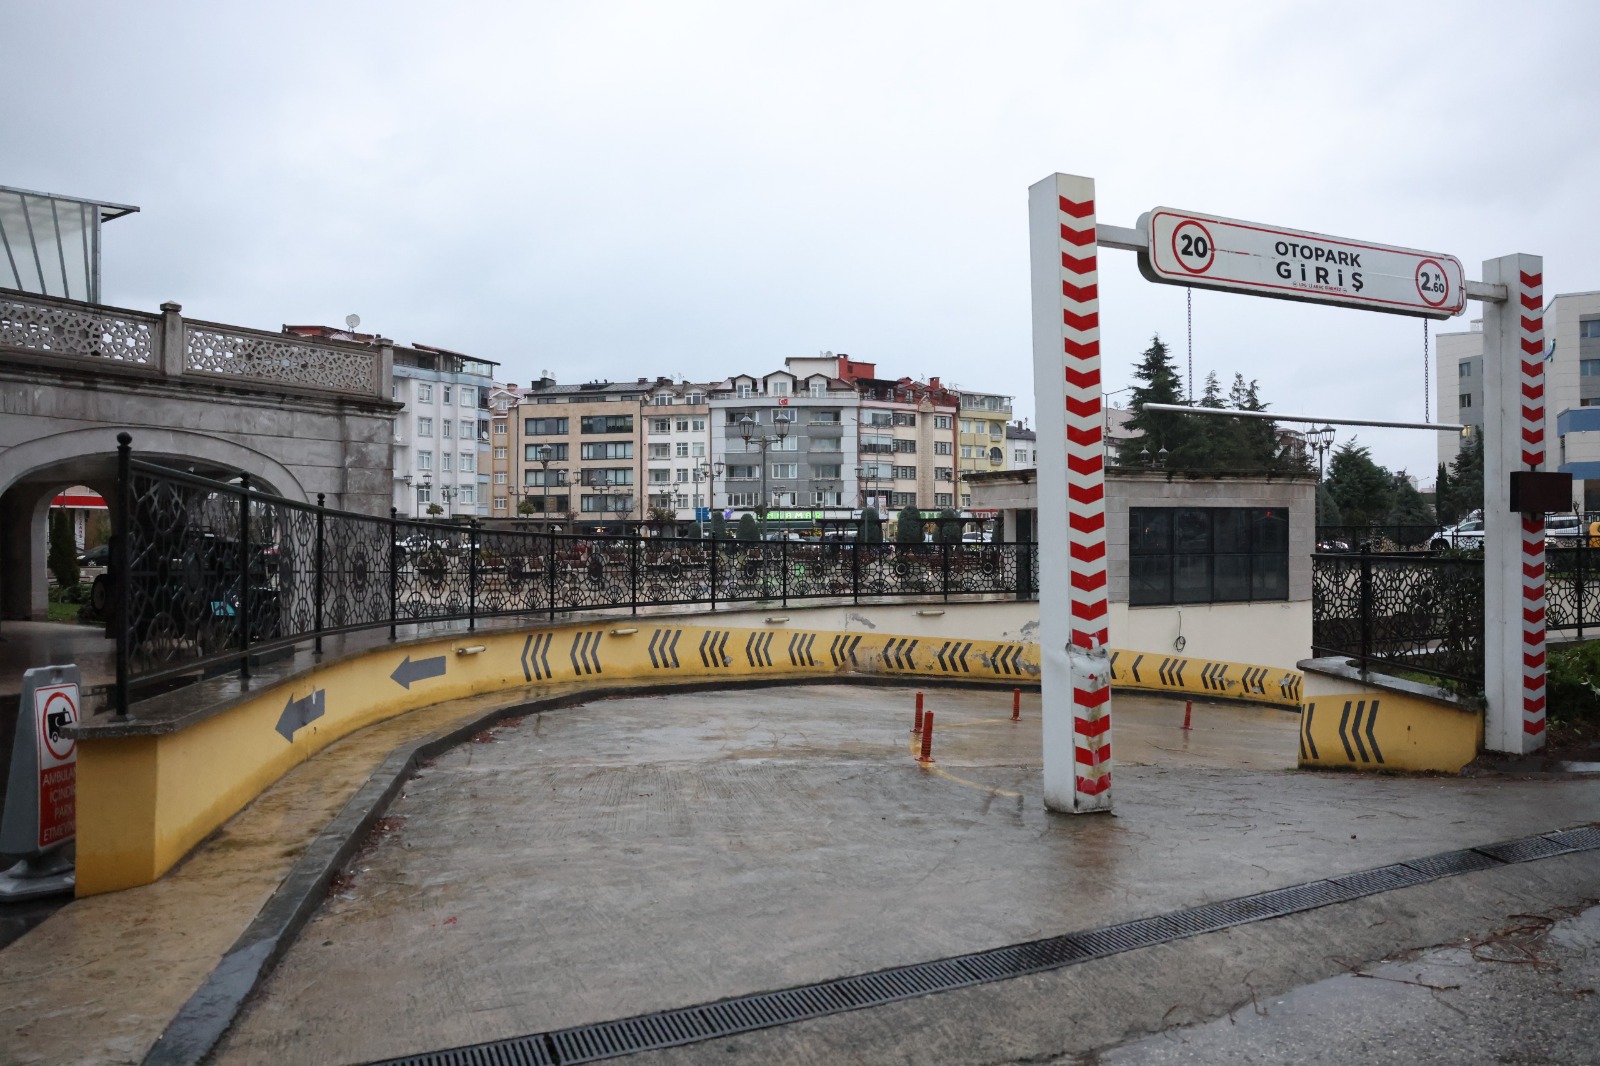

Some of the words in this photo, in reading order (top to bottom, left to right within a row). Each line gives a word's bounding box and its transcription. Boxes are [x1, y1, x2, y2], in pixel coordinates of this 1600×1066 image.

[1181, 233, 1208, 259] 20
[1275, 241, 1361, 268] OTOPARK
[1420, 271, 1445, 293] 2.60
[54, 803, 73, 820] PARK
